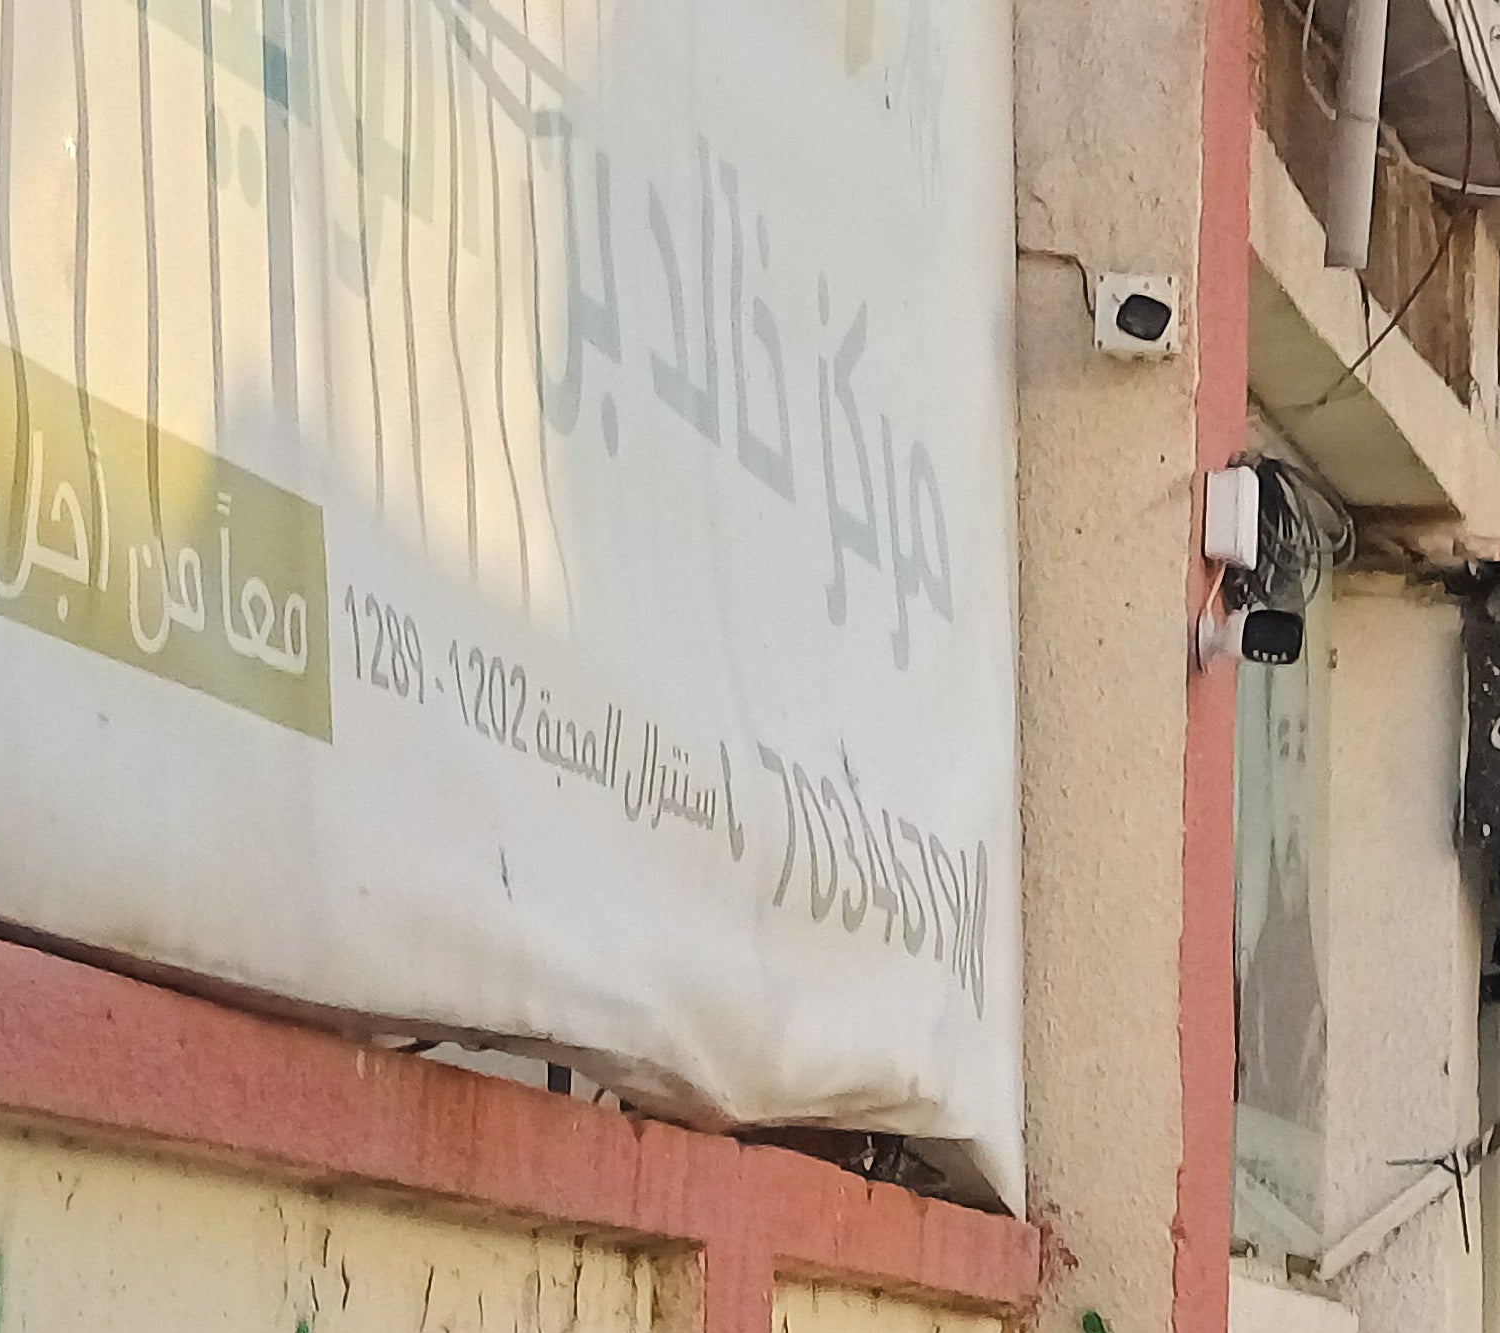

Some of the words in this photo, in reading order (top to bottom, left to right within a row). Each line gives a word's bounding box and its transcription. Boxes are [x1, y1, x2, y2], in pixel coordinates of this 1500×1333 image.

[128, 542, 205, 654] من
[345, 583, 426, 705] 1289
[449, 638, 528, 755] 1202
